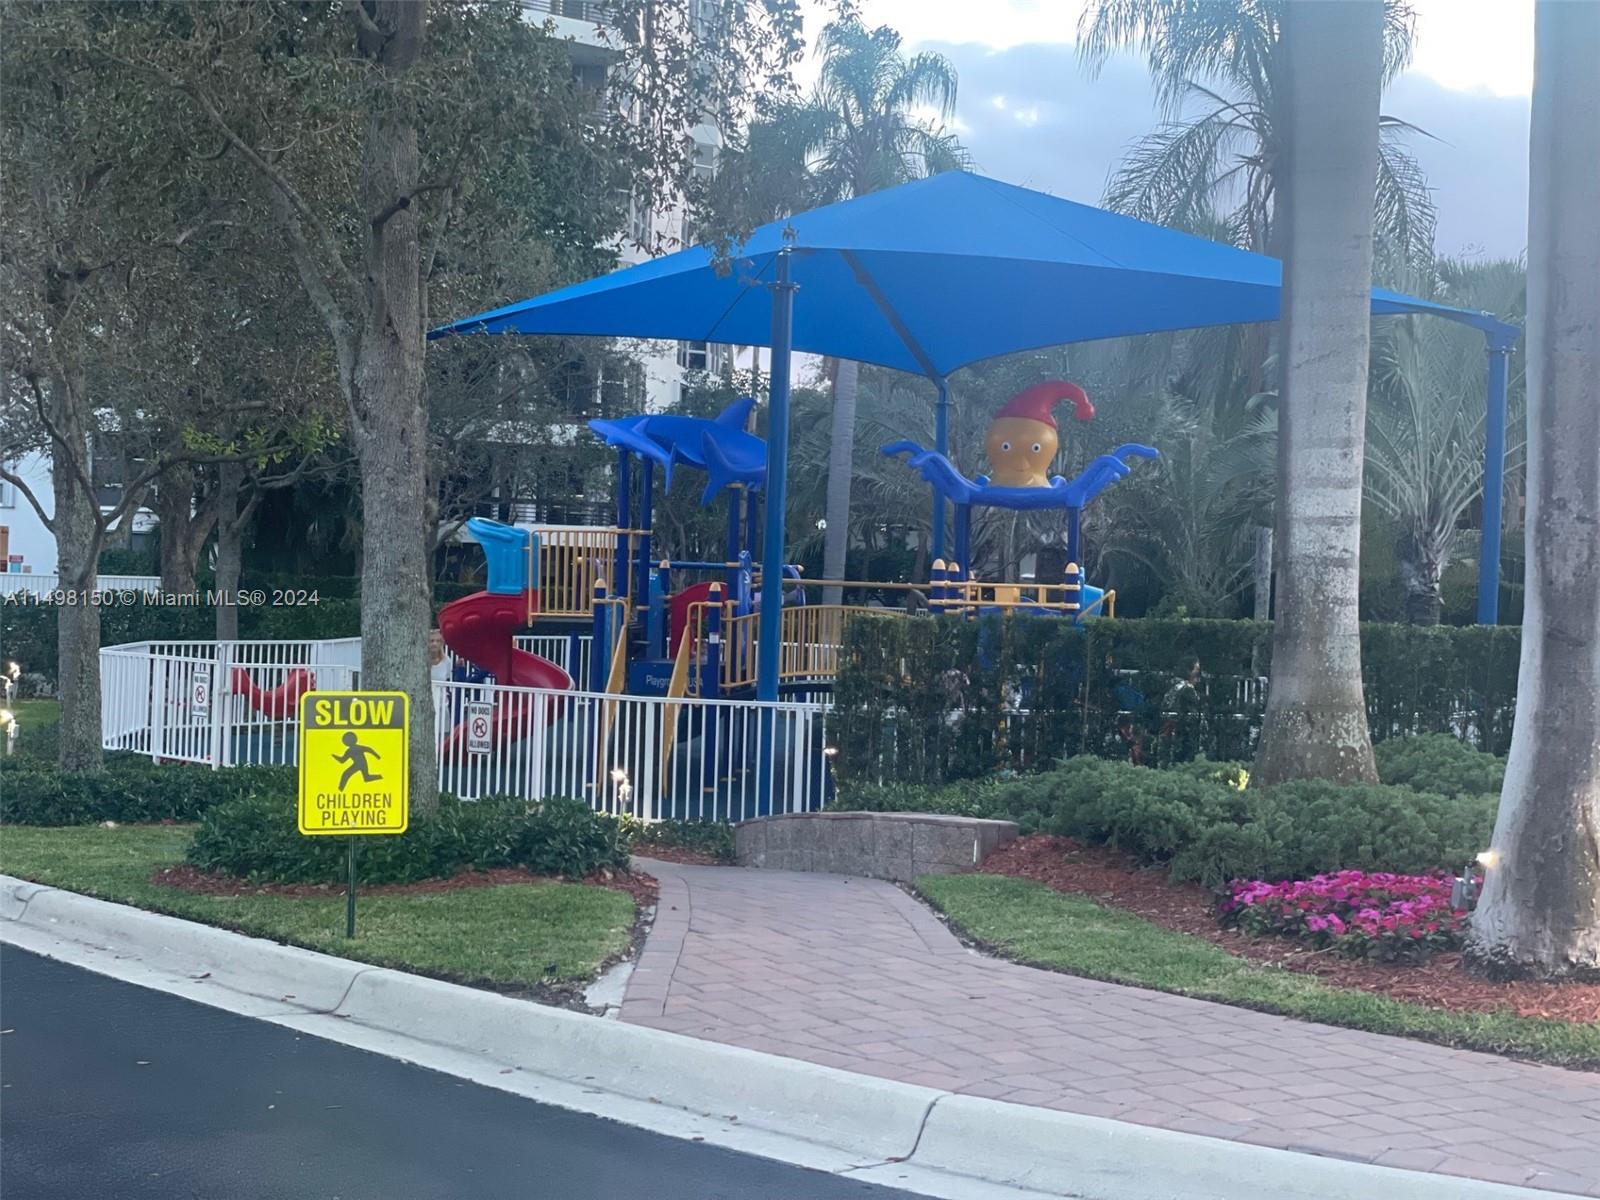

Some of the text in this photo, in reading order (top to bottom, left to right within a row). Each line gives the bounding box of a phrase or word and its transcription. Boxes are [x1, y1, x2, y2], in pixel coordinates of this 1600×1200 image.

[315, 699, 394, 726] SLOW
[316, 792, 392, 810] CHILDREN
[321, 810, 386, 827] PLAYING
